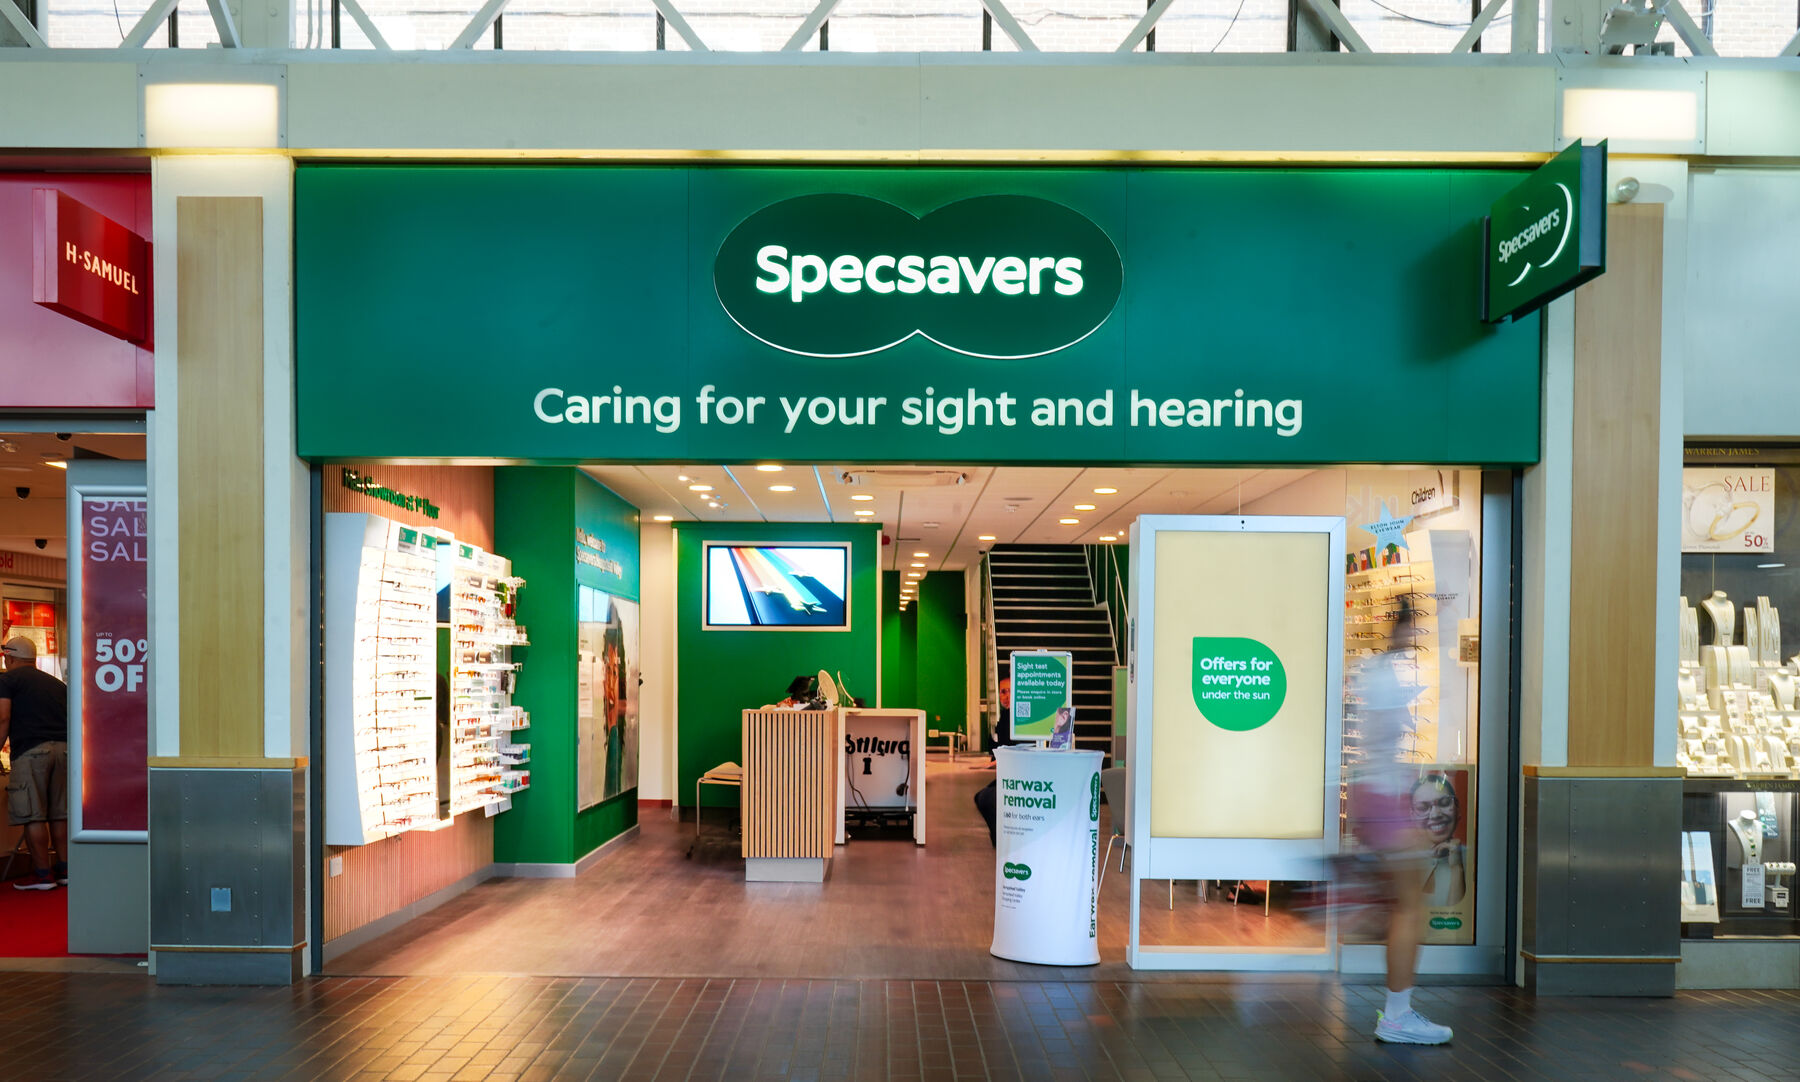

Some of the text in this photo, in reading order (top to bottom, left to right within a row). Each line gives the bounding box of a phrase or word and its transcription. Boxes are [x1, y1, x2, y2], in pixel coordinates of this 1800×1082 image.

[1498, 208, 1560, 264] Specsavers
[756, 244, 1084, 303] Specsavers
[533, 384, 1303, 437] Caring for your sight and hearing
[1723, 475, 1770, 492] SALE
[1411, 487, 1436, 505] Children
[1017, 662, 1034, 671] Sight
[1200, 656, 1273, 671] Offers for
[1017, 671, 1061, 679] appointments
[1202, 675, 1271, 688] everyone
[1046, 680, 1065, 688] today
[1202, 690, 1270, 700] under the sun
[1003, 794, 1056, 809] removal
